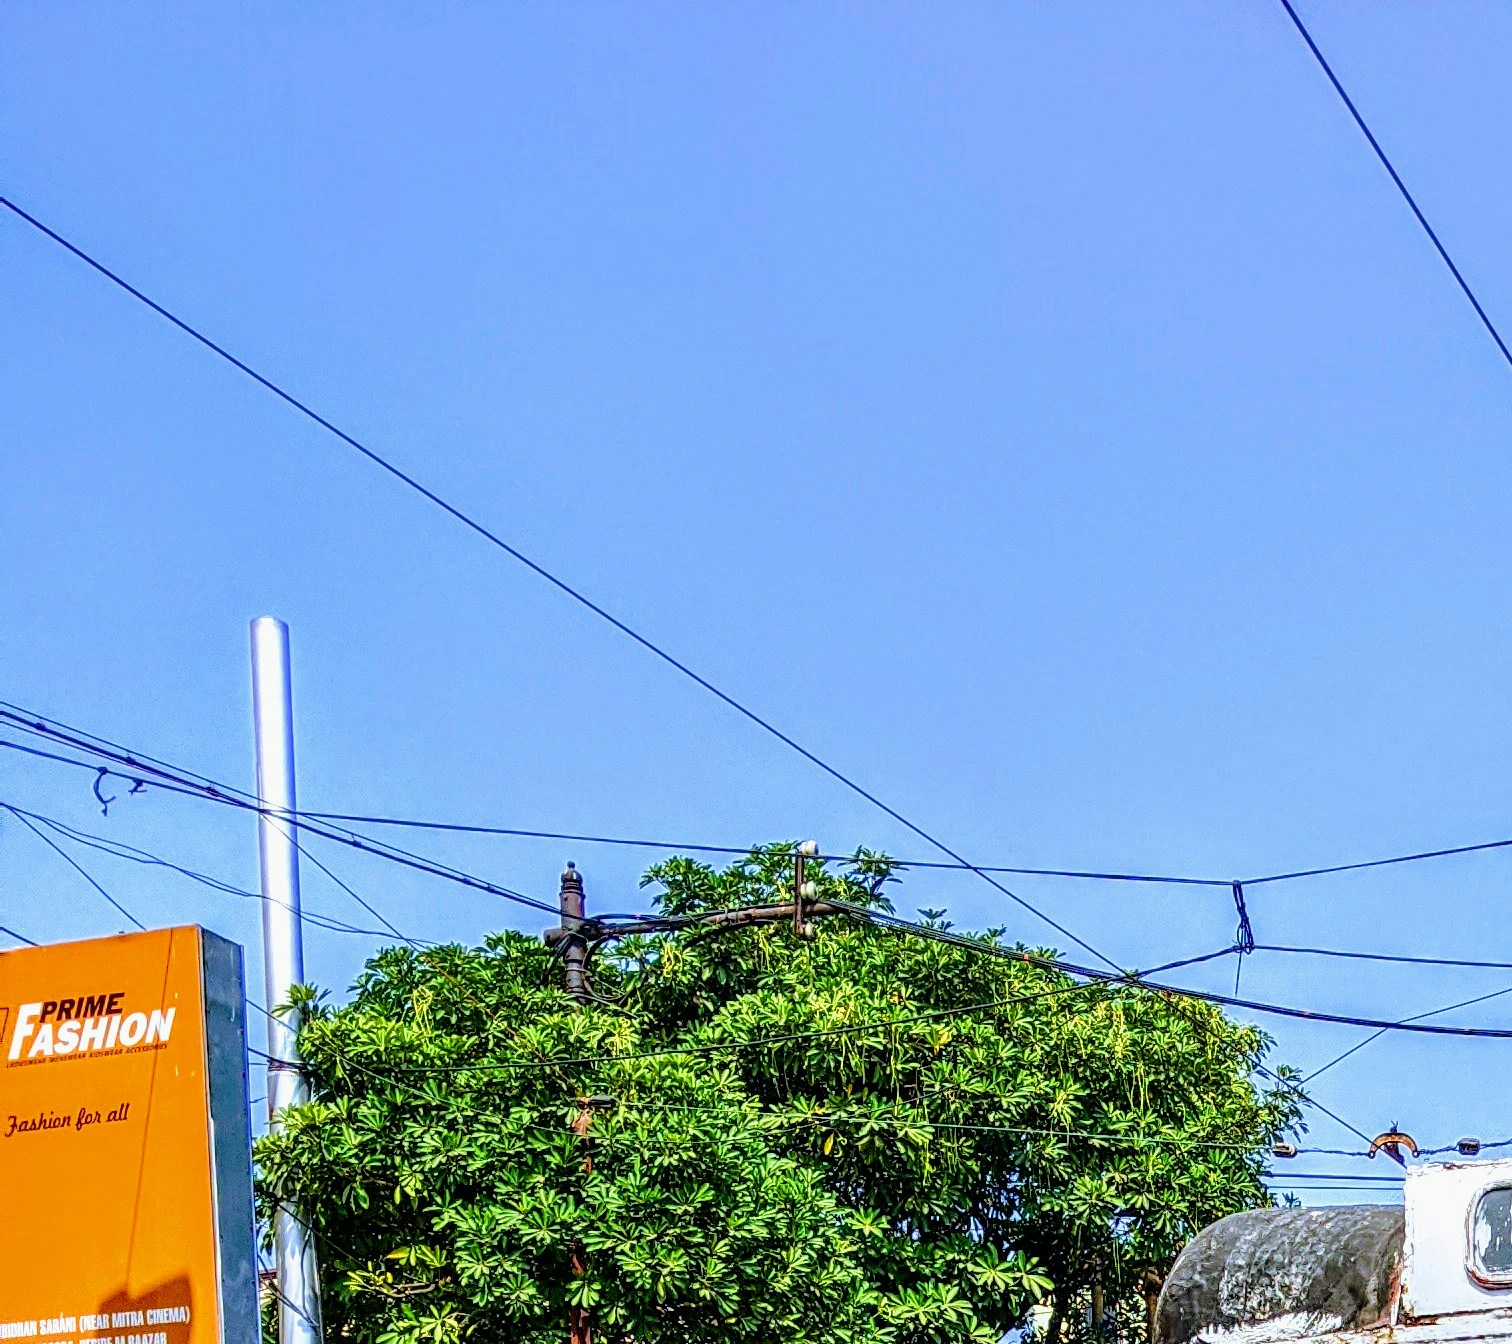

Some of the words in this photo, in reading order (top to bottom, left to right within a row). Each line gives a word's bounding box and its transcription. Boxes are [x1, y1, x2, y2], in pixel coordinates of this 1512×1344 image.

[40, 992, 125, 1023] PRIME
[8, 1002, 176, 1061] FASHION
[4, 1110, 71, 1137] Fashion
[75, 1107, 101, 1131] for
[106, 1102, 130, 1122] all
[112, 1311, 144, 1327] MITRA
[147, 1306, 191, 1325] CINEMA)
